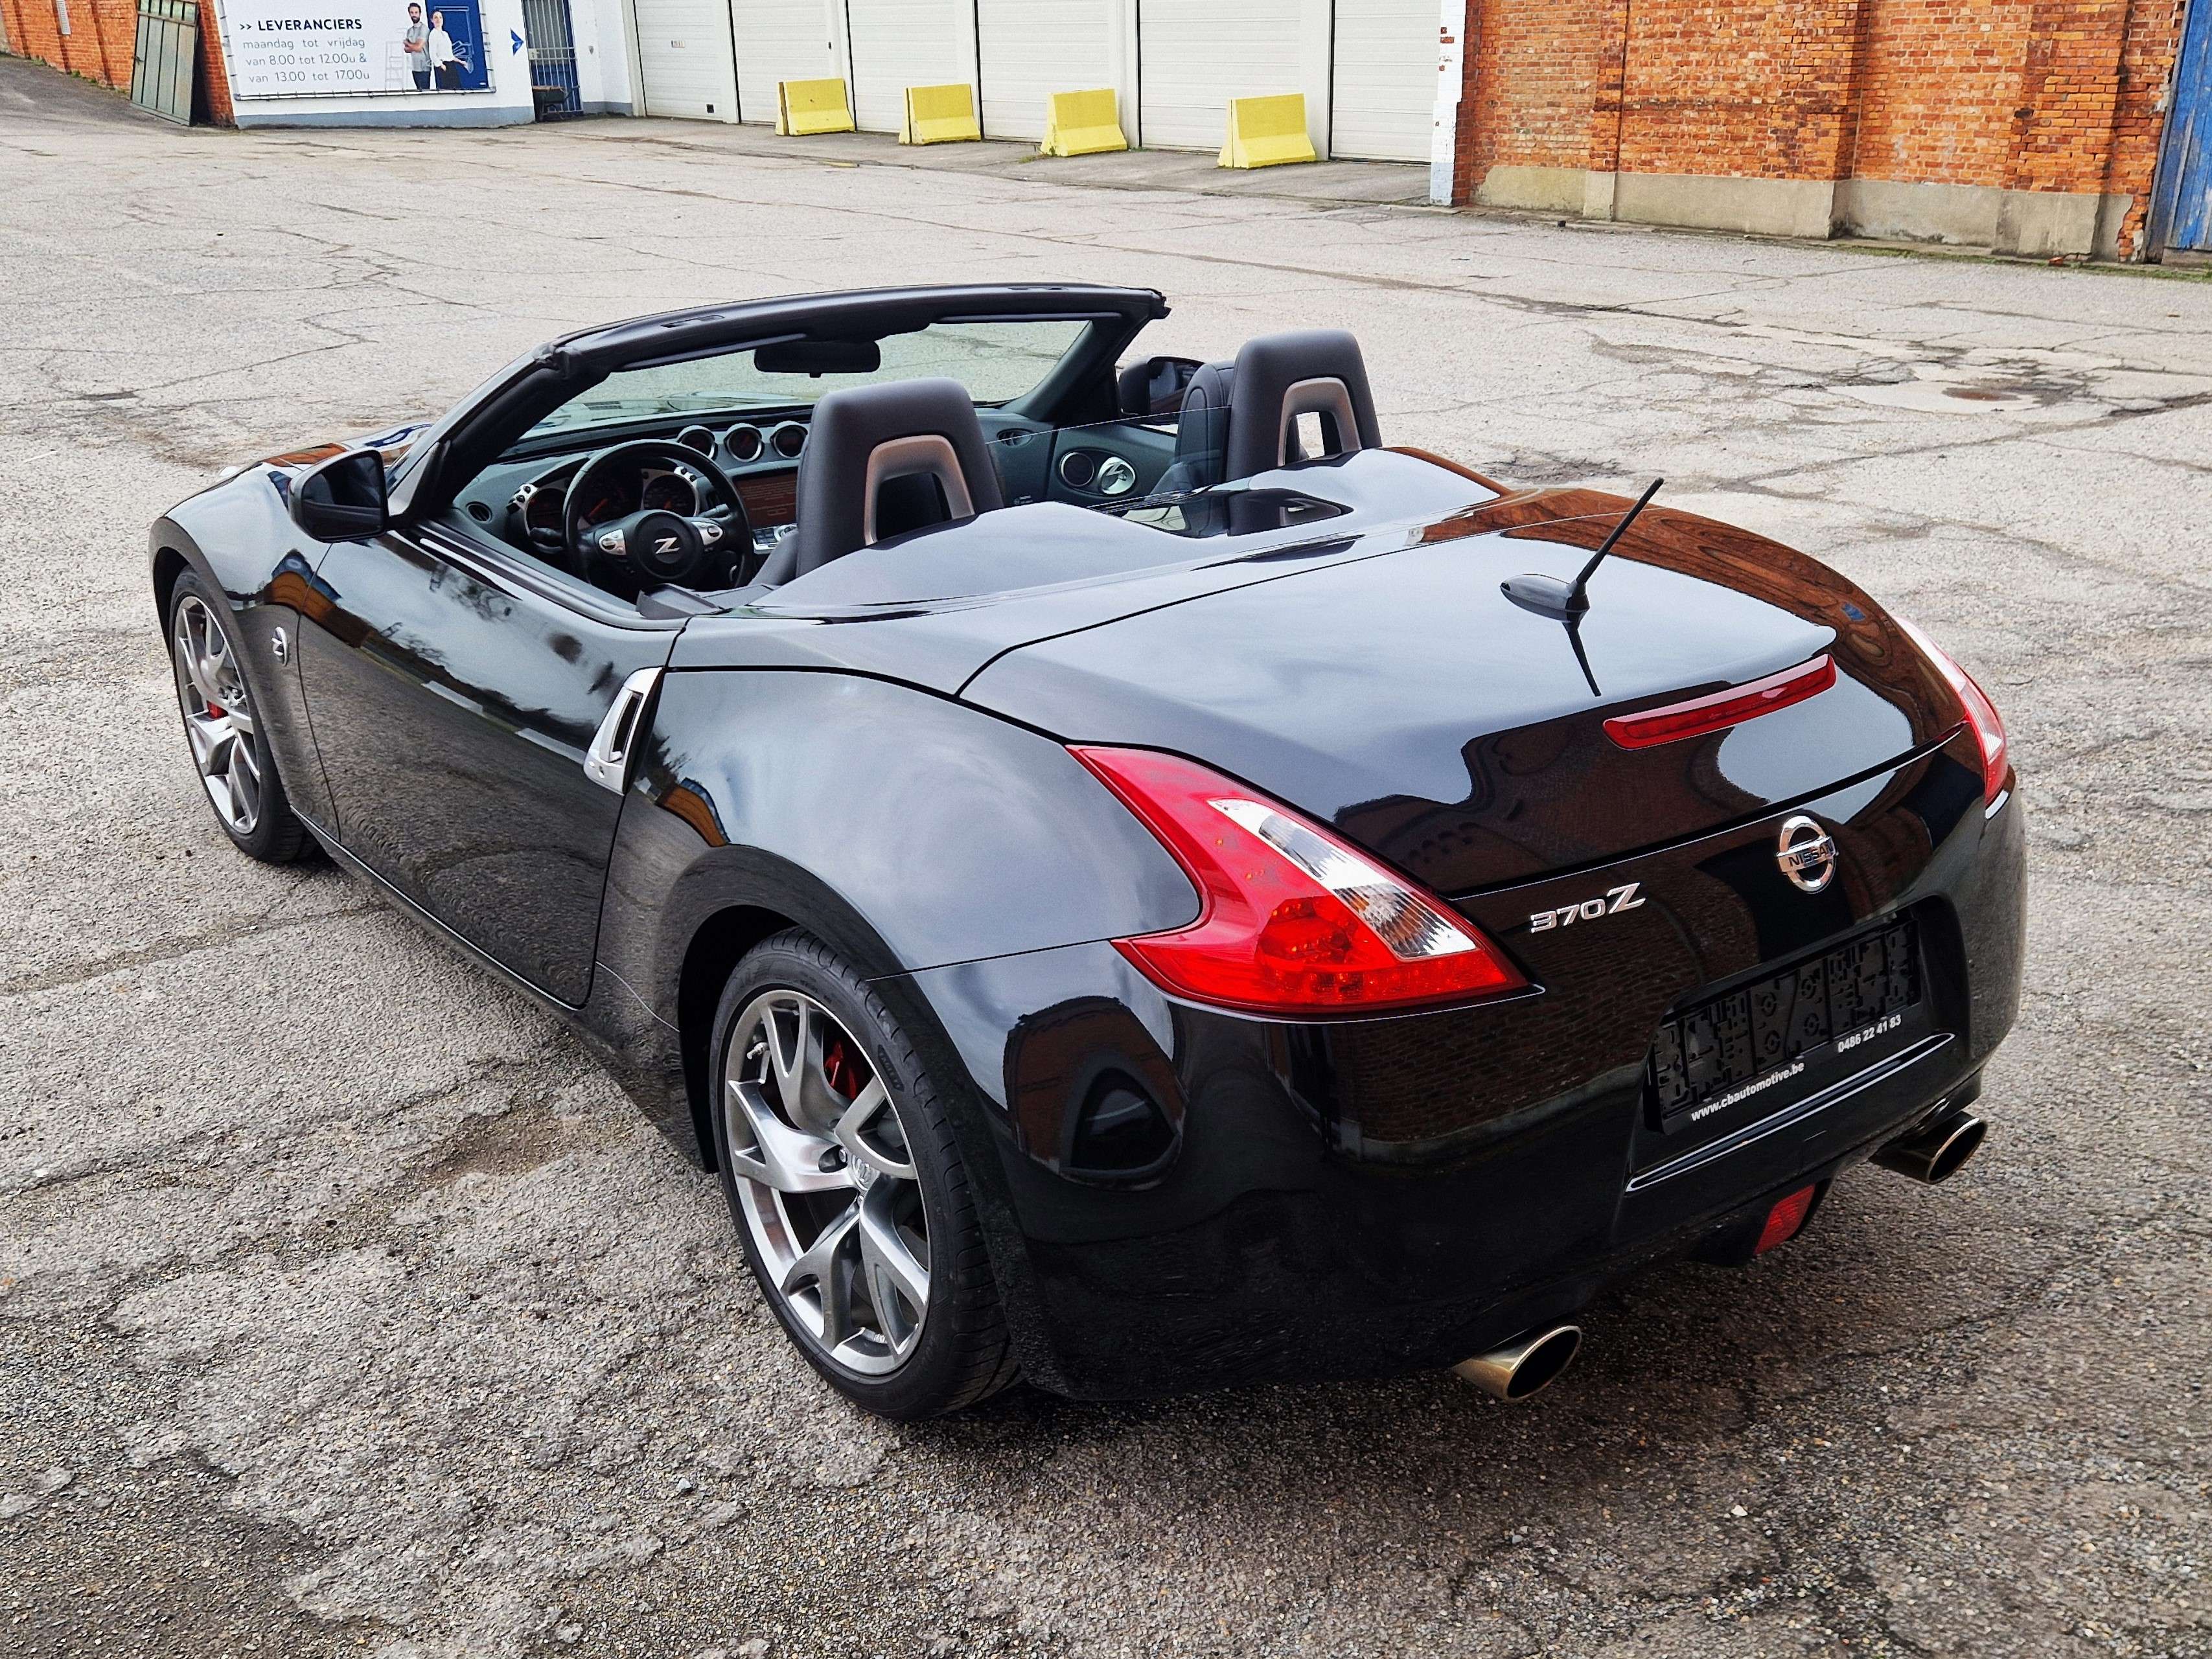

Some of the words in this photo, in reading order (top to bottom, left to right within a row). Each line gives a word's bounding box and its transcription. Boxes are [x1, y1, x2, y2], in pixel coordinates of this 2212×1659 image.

[258, 19, 363, 31] LEVERANCIERS
[243, 38, 294, 51] maandag
[327, 37, 365, 49] vrijdag
[269, 54, 295, 65] 8.00
[299, 56, 316, 64] tot
[359, 52, 367, 63] &
[312, 73, 329, 81] tot
[654, 536, 680, 555] Z
[1530, 882, 1646, 933] 370Z
[1838, 1033, 1861, 1053] 0486
[1862, 1027, 1875, 1042] 22
[1876, 1020, 1887, 1034] 41
[1690, 1062, 1805, 1121] www.cbautomotive.be
